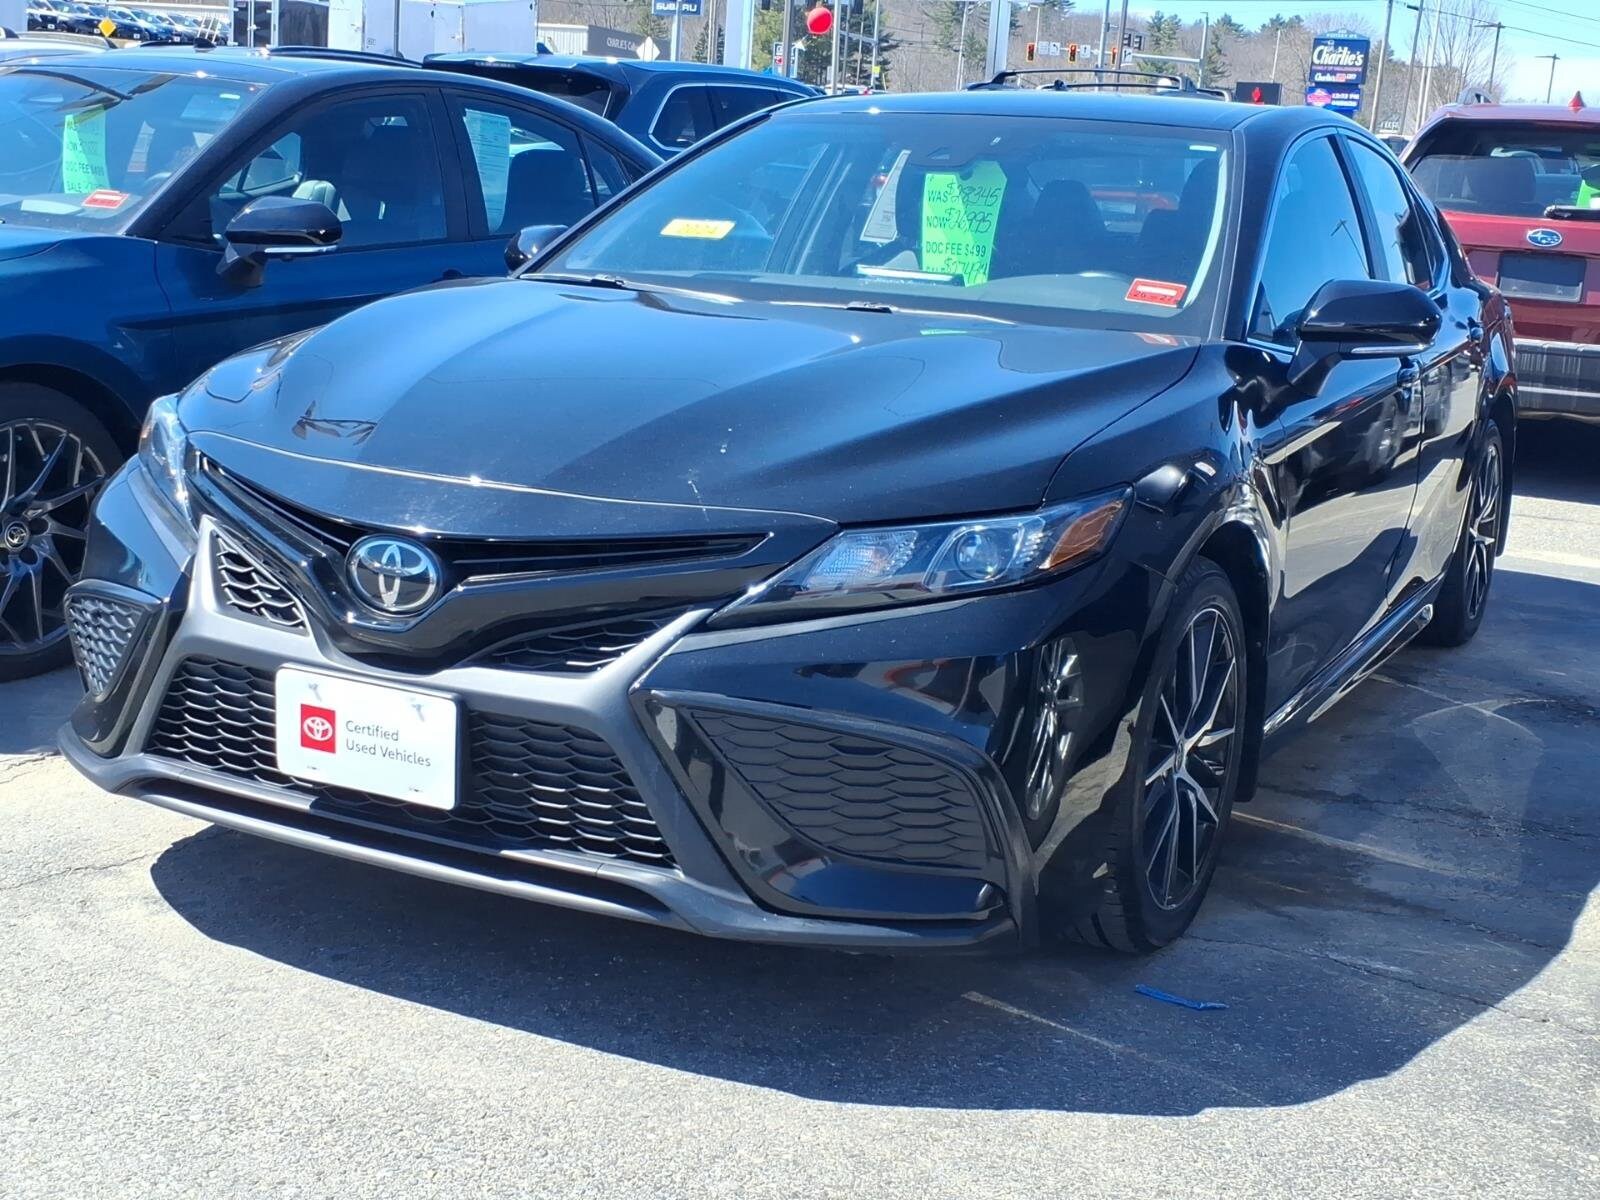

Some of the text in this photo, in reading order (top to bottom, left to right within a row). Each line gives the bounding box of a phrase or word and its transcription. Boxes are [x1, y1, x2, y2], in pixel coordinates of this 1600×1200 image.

[656, 2, 697, 12] SUBRU
[1312, 45, 1364, 66] Charlie's
[928, 190, 948, 203] WAS
[926, 215, 948, 229] NOW
[926, 241, 986, 257] DOC FEE $499
[345, 720, 399, 741] Certified
[346, 738, 431, 767] Used Vehicles
